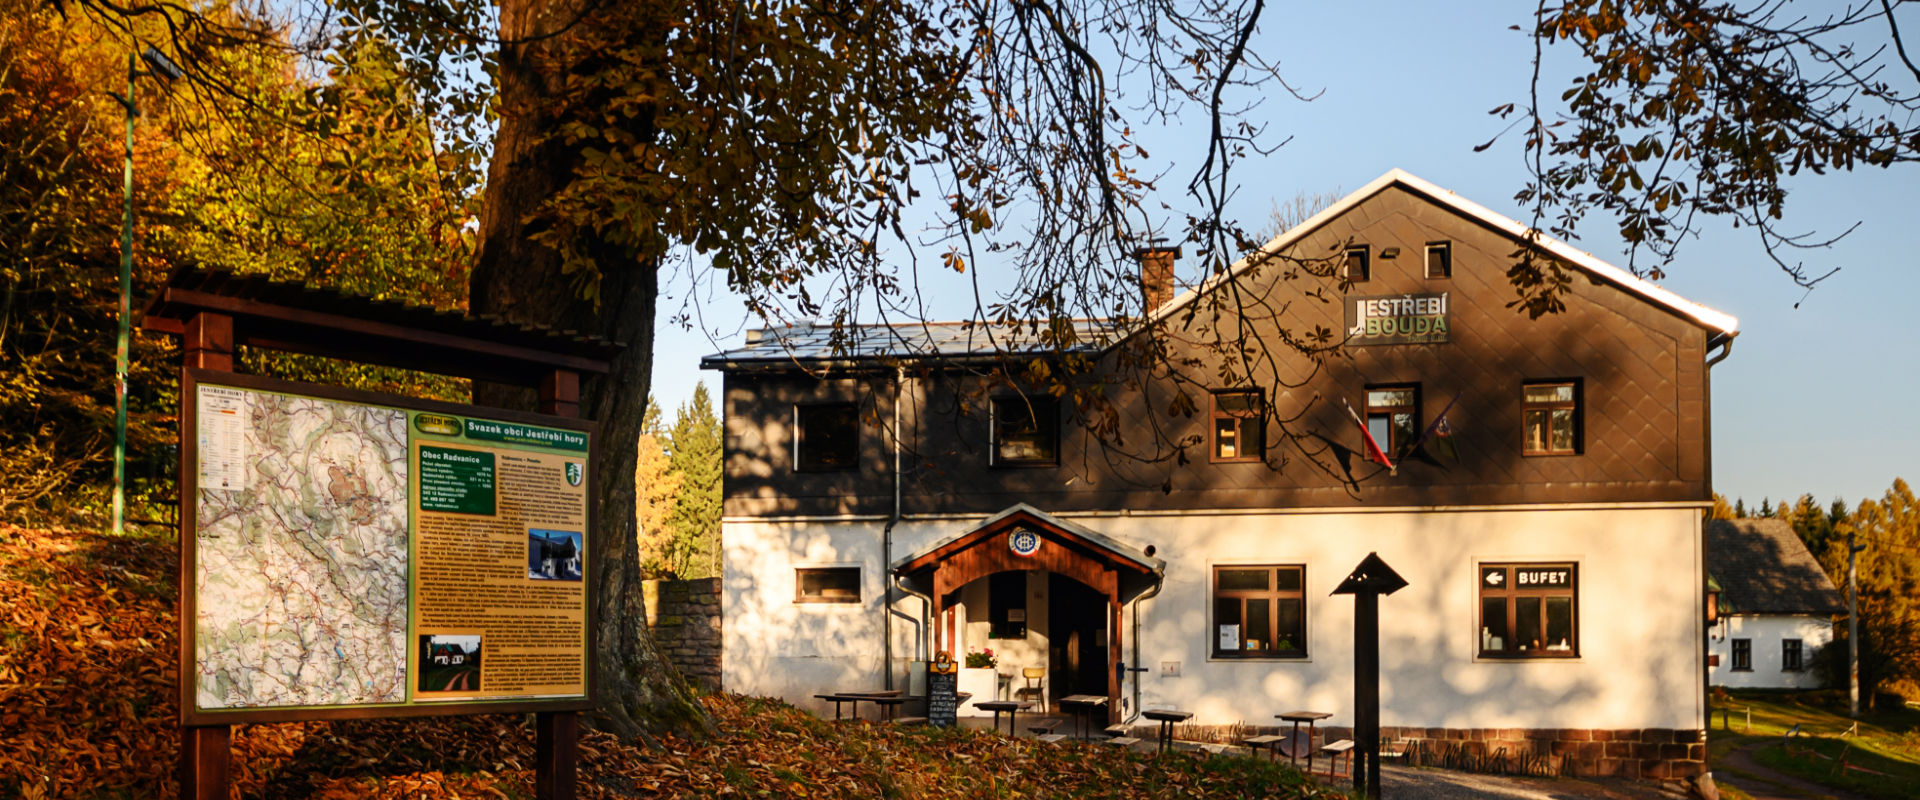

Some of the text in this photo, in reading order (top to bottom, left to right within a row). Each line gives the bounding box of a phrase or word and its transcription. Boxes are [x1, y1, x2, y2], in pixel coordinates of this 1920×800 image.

[1349, 292, 1447, 335] JESTŘEBÍ
[1366, 316, 1447, 335] BOUDA
[418, 415, 443, 425] JESTŘEBÍ
[468, 421, 584, 445] Svazek obcí Jestřebí hory
[422, 450, 480, 464] Obec Radvanice
[1519, 572, 1567, 584] BUFET
